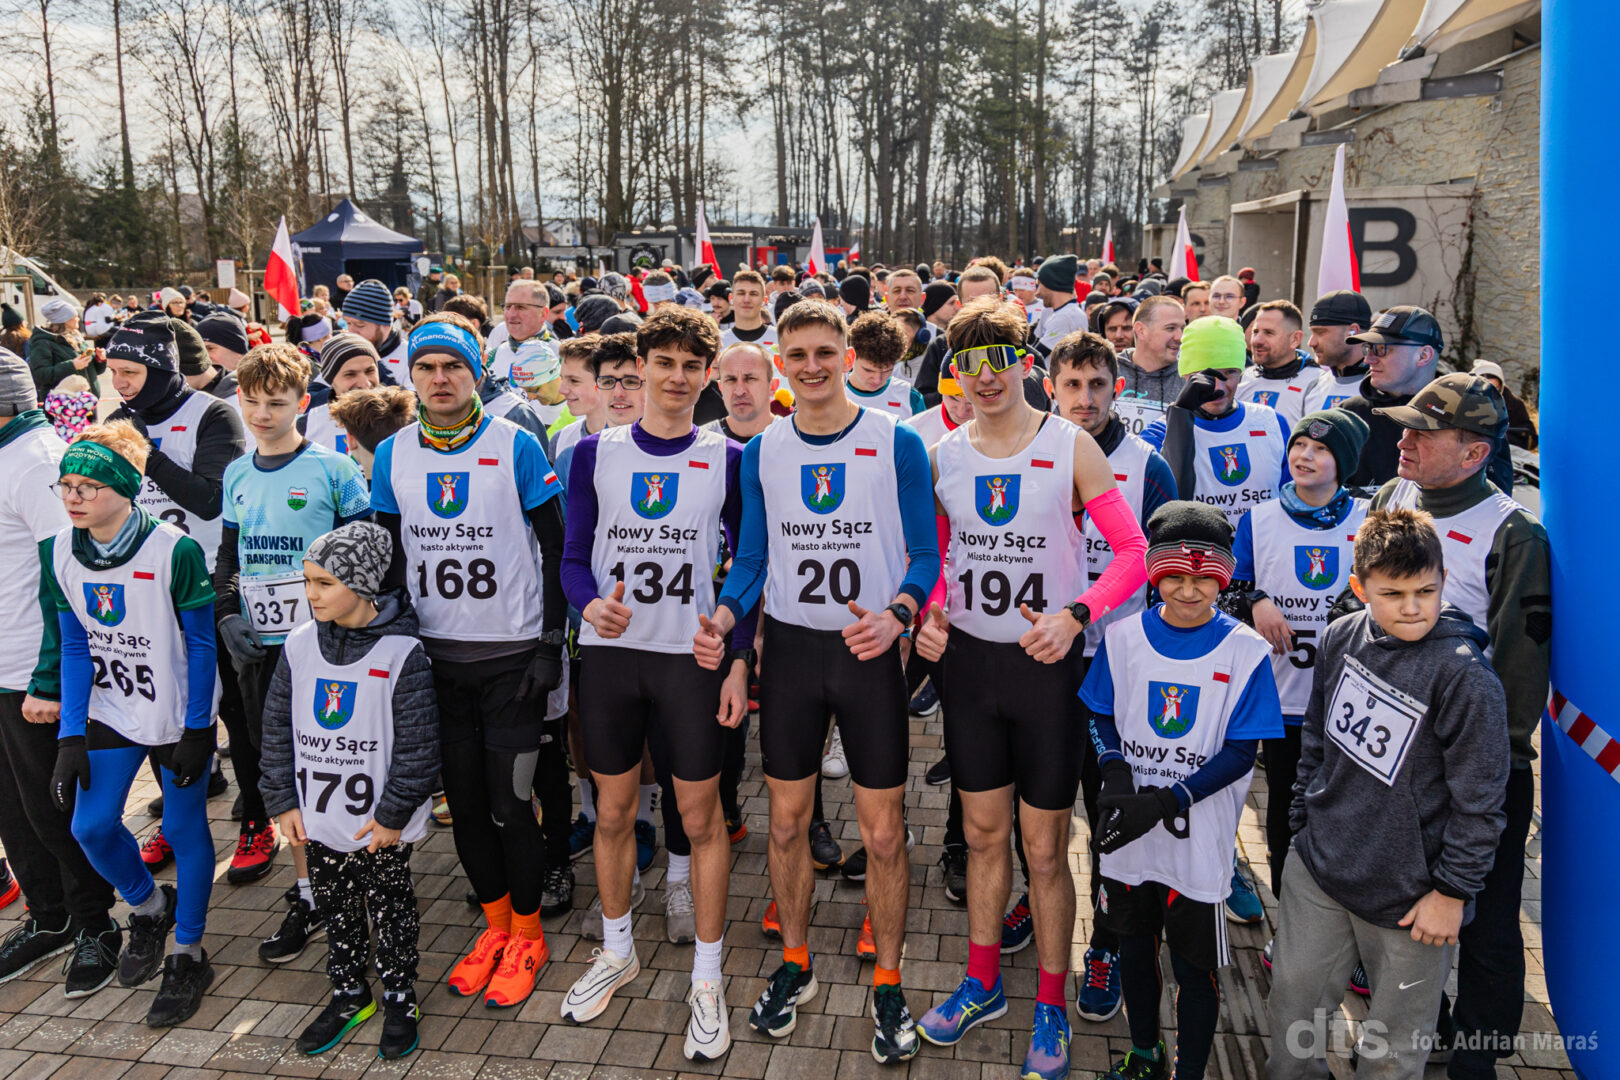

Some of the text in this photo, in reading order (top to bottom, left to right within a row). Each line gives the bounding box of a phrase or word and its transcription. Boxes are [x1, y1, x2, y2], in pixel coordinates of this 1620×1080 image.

[1347, 207, 1417, 287] B
[1195, 493, 1237, 506] Nowy
[409, 523, 493, 541] Nowy Sącz
[607, 524, 698, 544] Nowy Sącz
[781, 519, 872, 539] Nowy Sącz
[445, 543, 484, 553] aktywne
[617, 545, 687, 556] Miasto aktywne
[791, 541, 861, 552] Miasto aktywne
[958, 531, 1046, 552] Nowy Sącz
[967, 551, 1034, 565] Miasto aktywne
[417, 557, 498, 600] 168
[609, 561, 695, 605] 134
[797, 558, 861, 605] 20
[958, 568, 1048, 617] 194
[1273, 594, 1320, 611] Nowy
[254, 598, 299, 626] 337
[1284, 613, 1313, 622] Miasto
[90, 655, 156, 703] 265
[1336, 701, 1392, 759] 343
[296, 728, 378, 755] Nowy Sącz
[1123, 740, 1169, 763] Nowy
[300, 750, 365, 767] Miasto aktywne
[296, 767, 375, 816] 179
